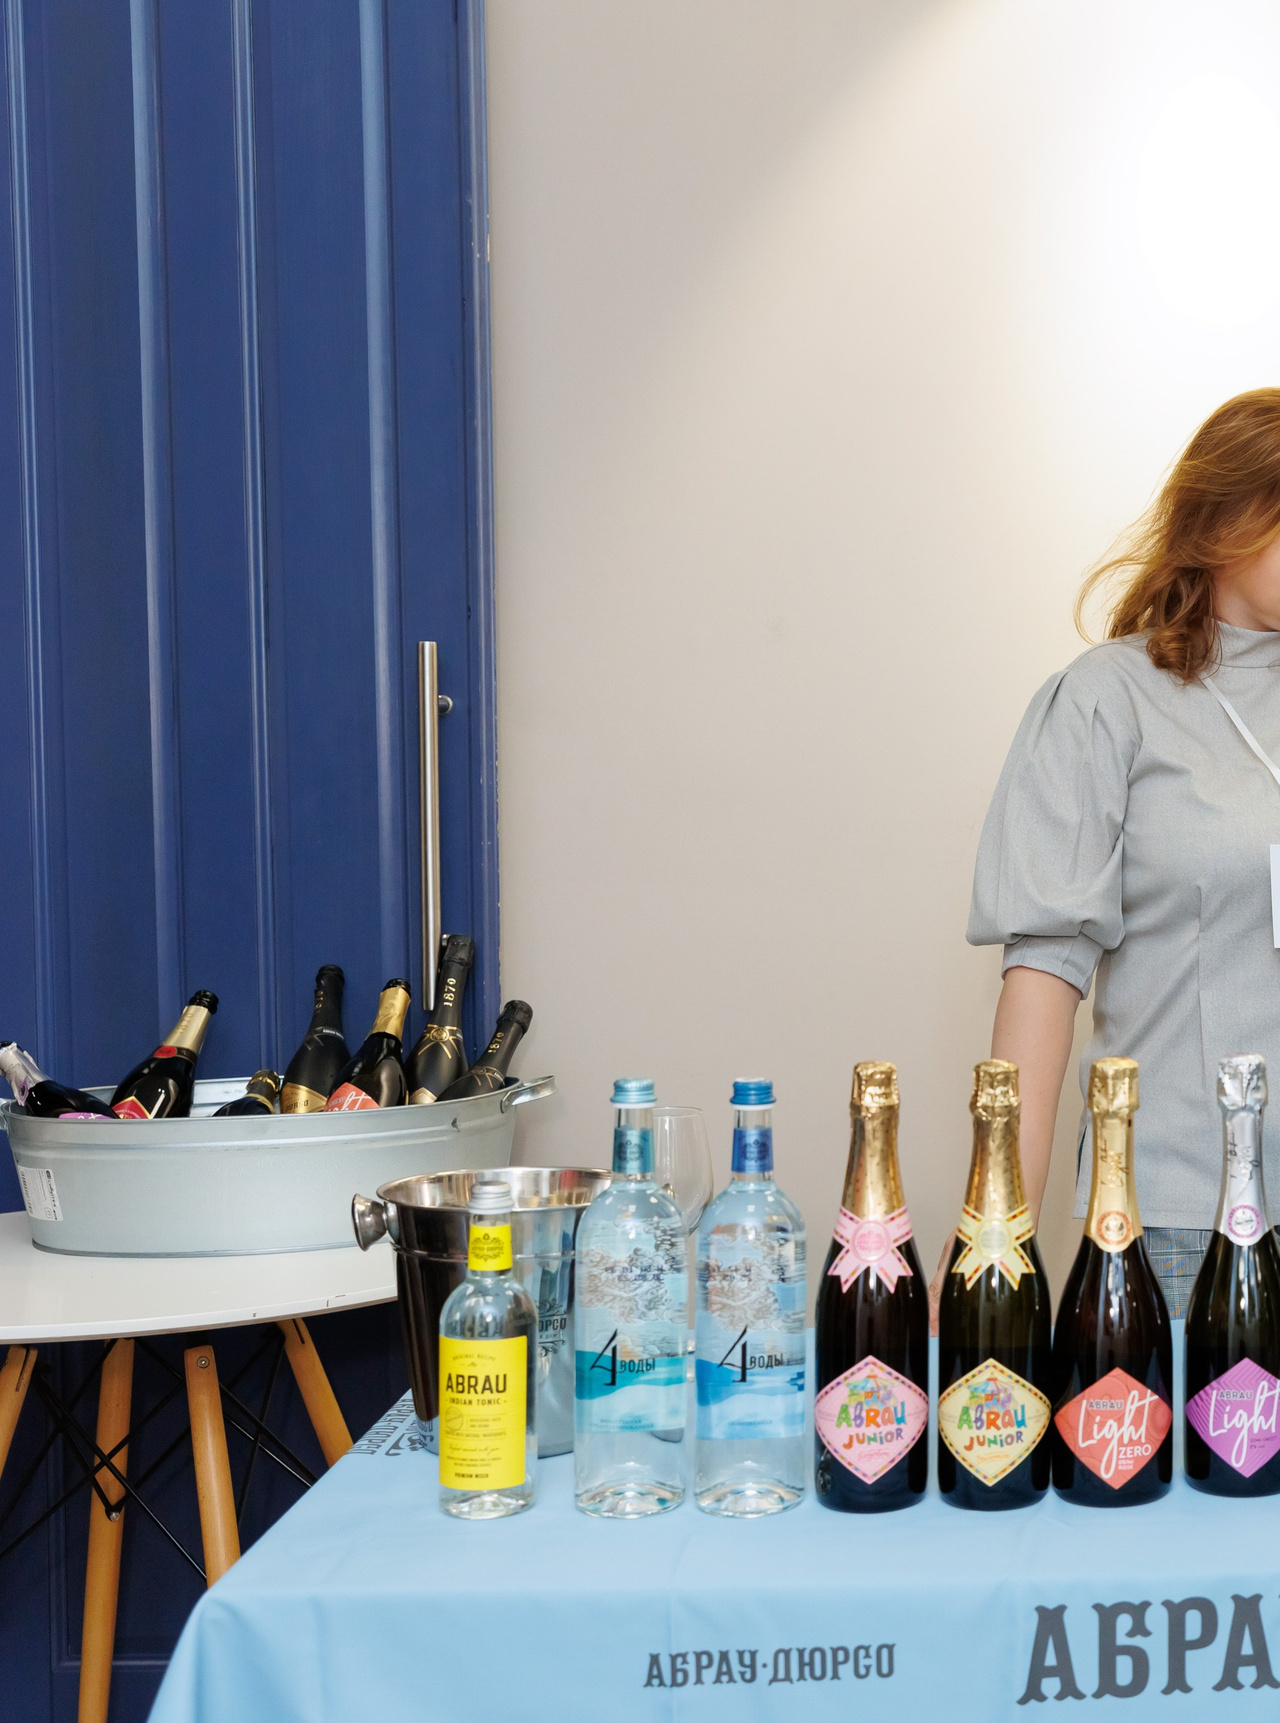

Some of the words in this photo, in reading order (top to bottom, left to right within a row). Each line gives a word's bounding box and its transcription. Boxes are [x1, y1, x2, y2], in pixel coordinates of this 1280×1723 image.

[443, 977, 456, 1007] 1870
[446, 1372, 507, 1395] ABRAU
[449, 1397, 473, 1406] INDIAN
[477, 1397, 501, 1406] TONIC
[1219, 1390, 1253, 1400] ABRAU
[1088, 1399, 1124, 1410] ABRAU
[1078, 1389, 1160, 1479] Light
[1118, 1444, 1152, 1459] ZERO
